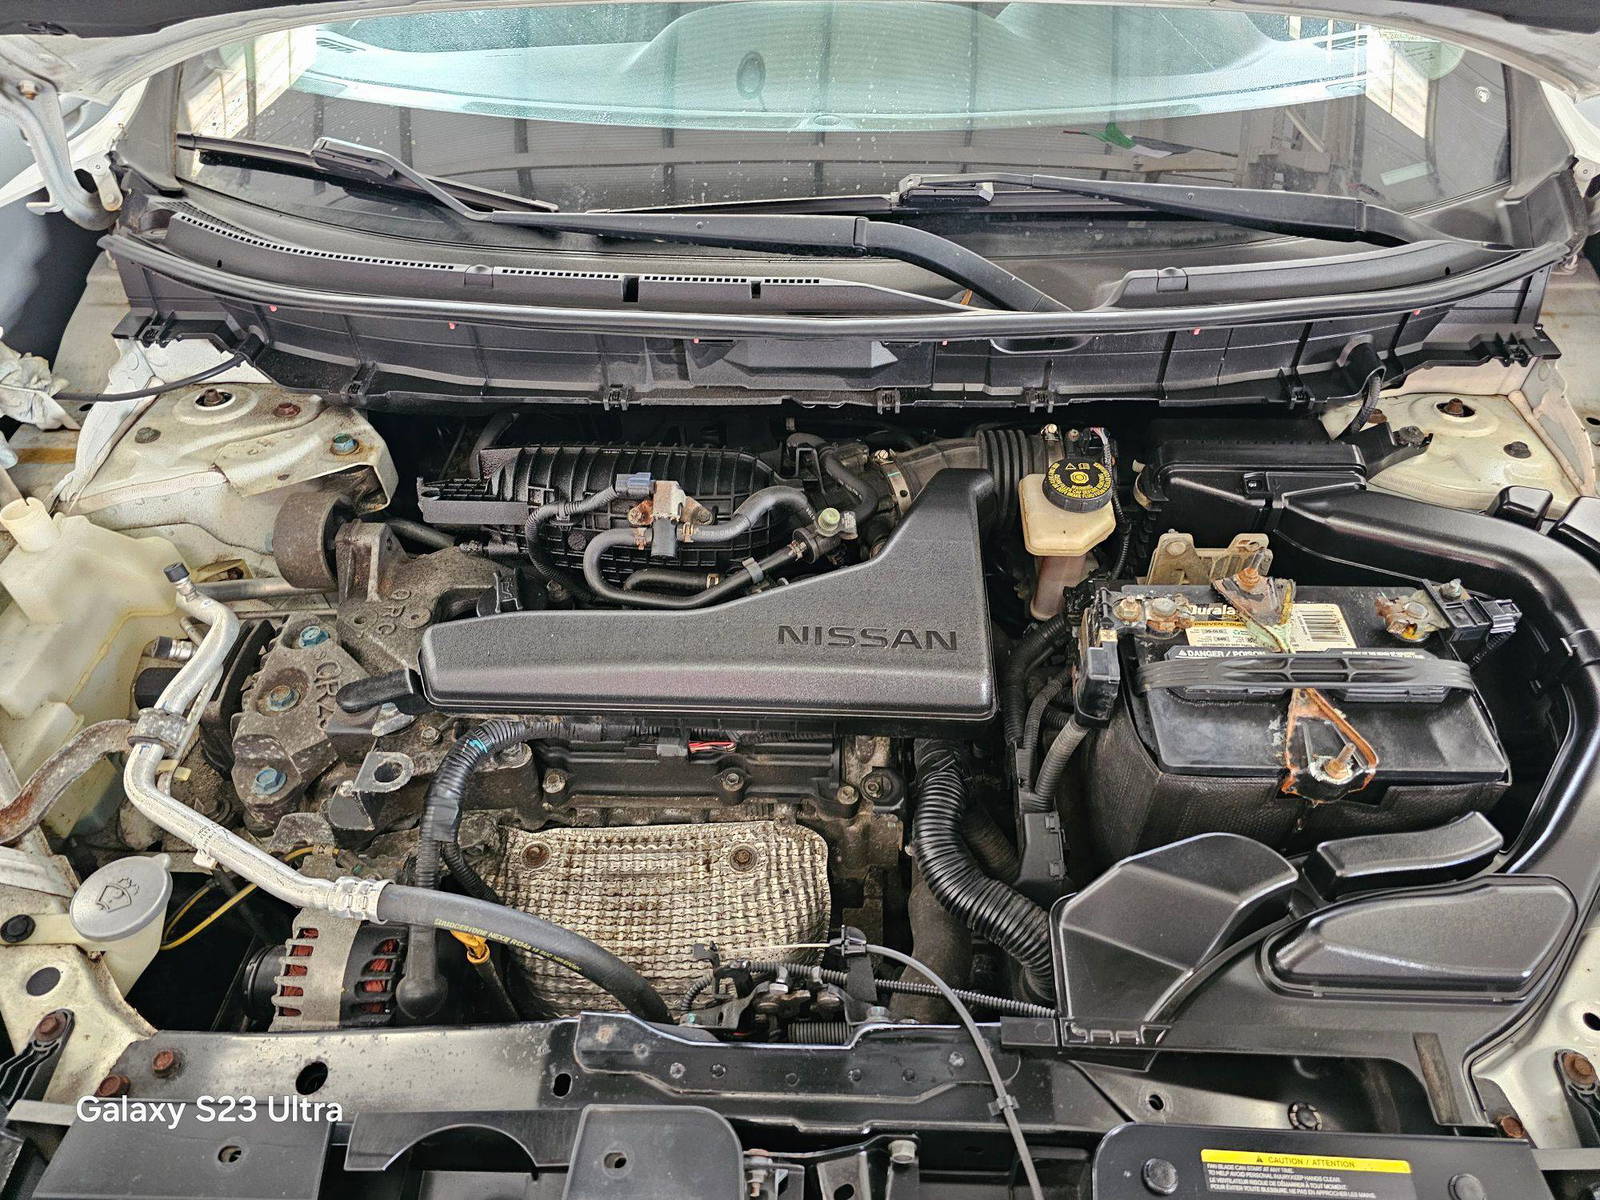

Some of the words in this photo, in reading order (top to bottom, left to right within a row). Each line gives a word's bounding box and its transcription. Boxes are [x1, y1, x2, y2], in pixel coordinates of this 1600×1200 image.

[777, 625, 958, 651] NISSAN
[1187, 650, 1225, 658] DANGER
[1268, 1156, 1303, 1164] CAUTION
[1312, 1159, 1355, 1169] ATTENTION
